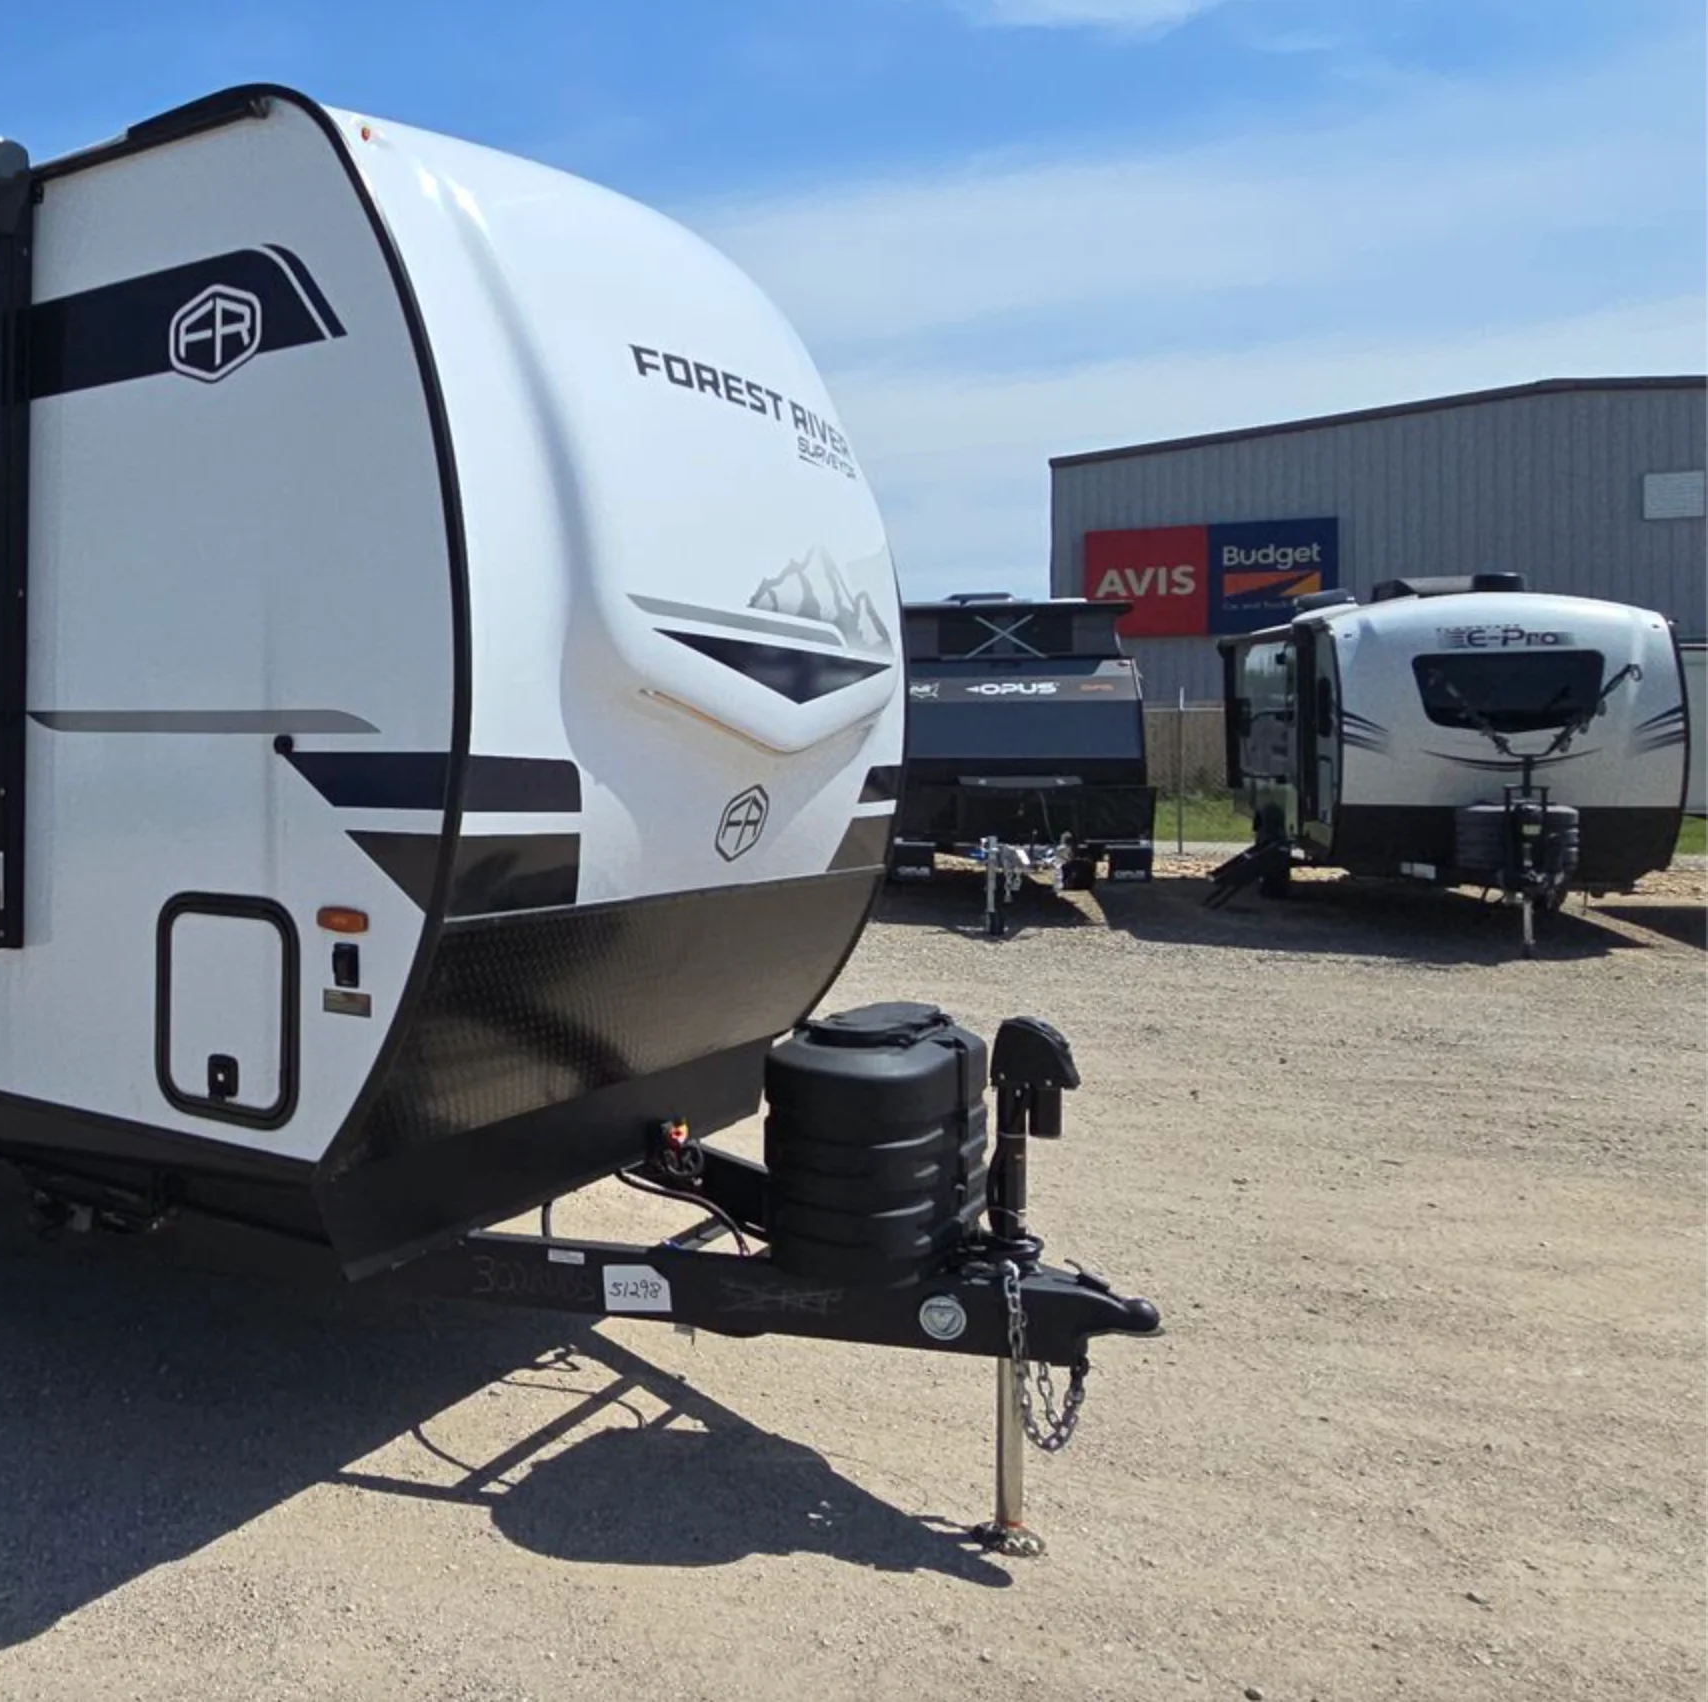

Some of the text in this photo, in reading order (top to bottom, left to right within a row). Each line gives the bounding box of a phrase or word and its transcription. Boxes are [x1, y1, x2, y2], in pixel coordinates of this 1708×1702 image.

[628, 343, 852, 461] FOREST RIVER
[1223, 543, 1322, 570] Budget
[1095, 565, 1197, 598] AVIS
[1466, 628, 1559, 647] E-Pro
[979, 682, 1059, 695] OPUS
[608, 1279, 662, 1299] 51298
